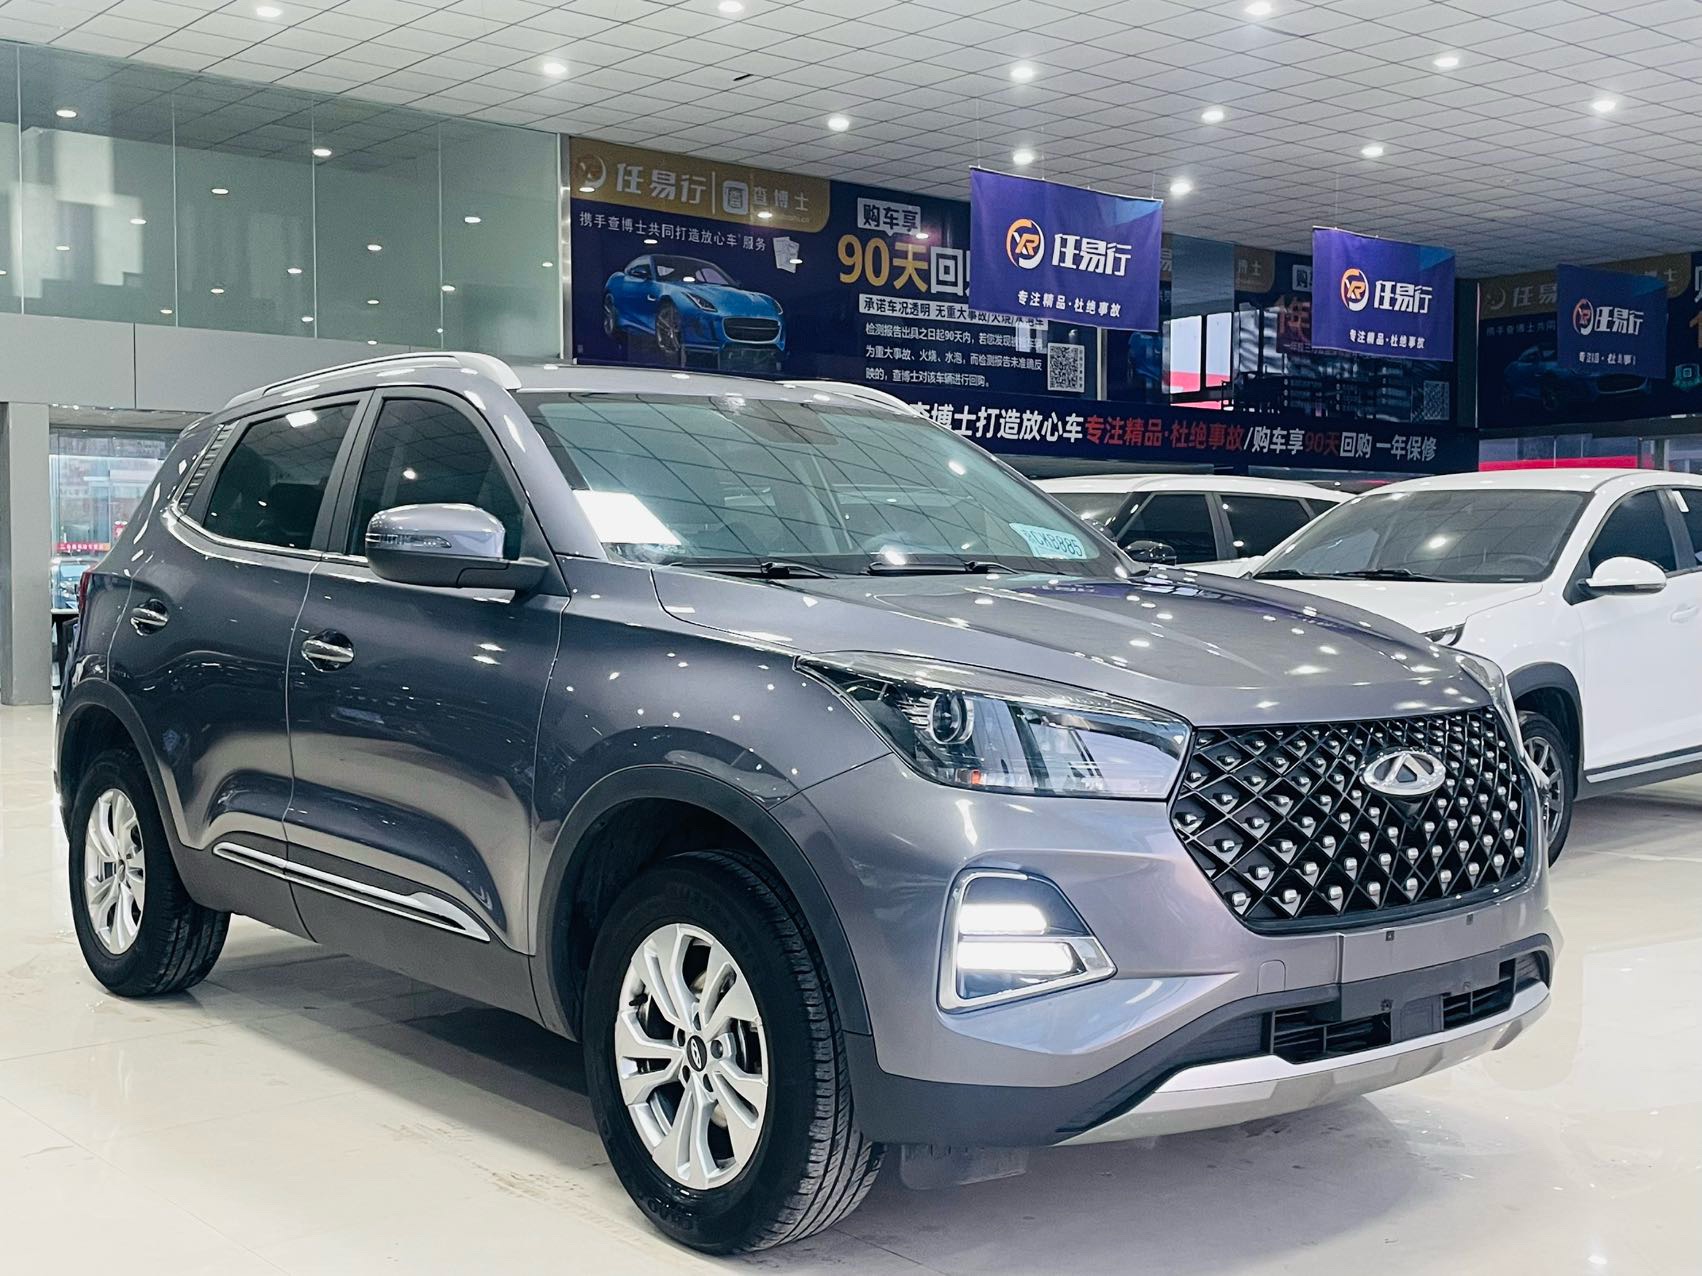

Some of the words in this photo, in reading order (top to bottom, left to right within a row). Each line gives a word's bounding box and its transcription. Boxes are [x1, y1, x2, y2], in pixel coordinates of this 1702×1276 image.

[616, 163, 706, 204] 任易行
[753, 186, 809, 212] 查博士
[863, 204, 918, 232] 购车享
[837, 234, 970, 297] 90天回
[1051, 233, 1132, 276] 任易行
[863, 296, 931, 317] 承诺车况透明
[1017, 290, 1121, 318] 专注精品·杜绝事故
[1373, 280, 1433, 314] 任易行
[1594, 306, 1645, 336] 任易行
